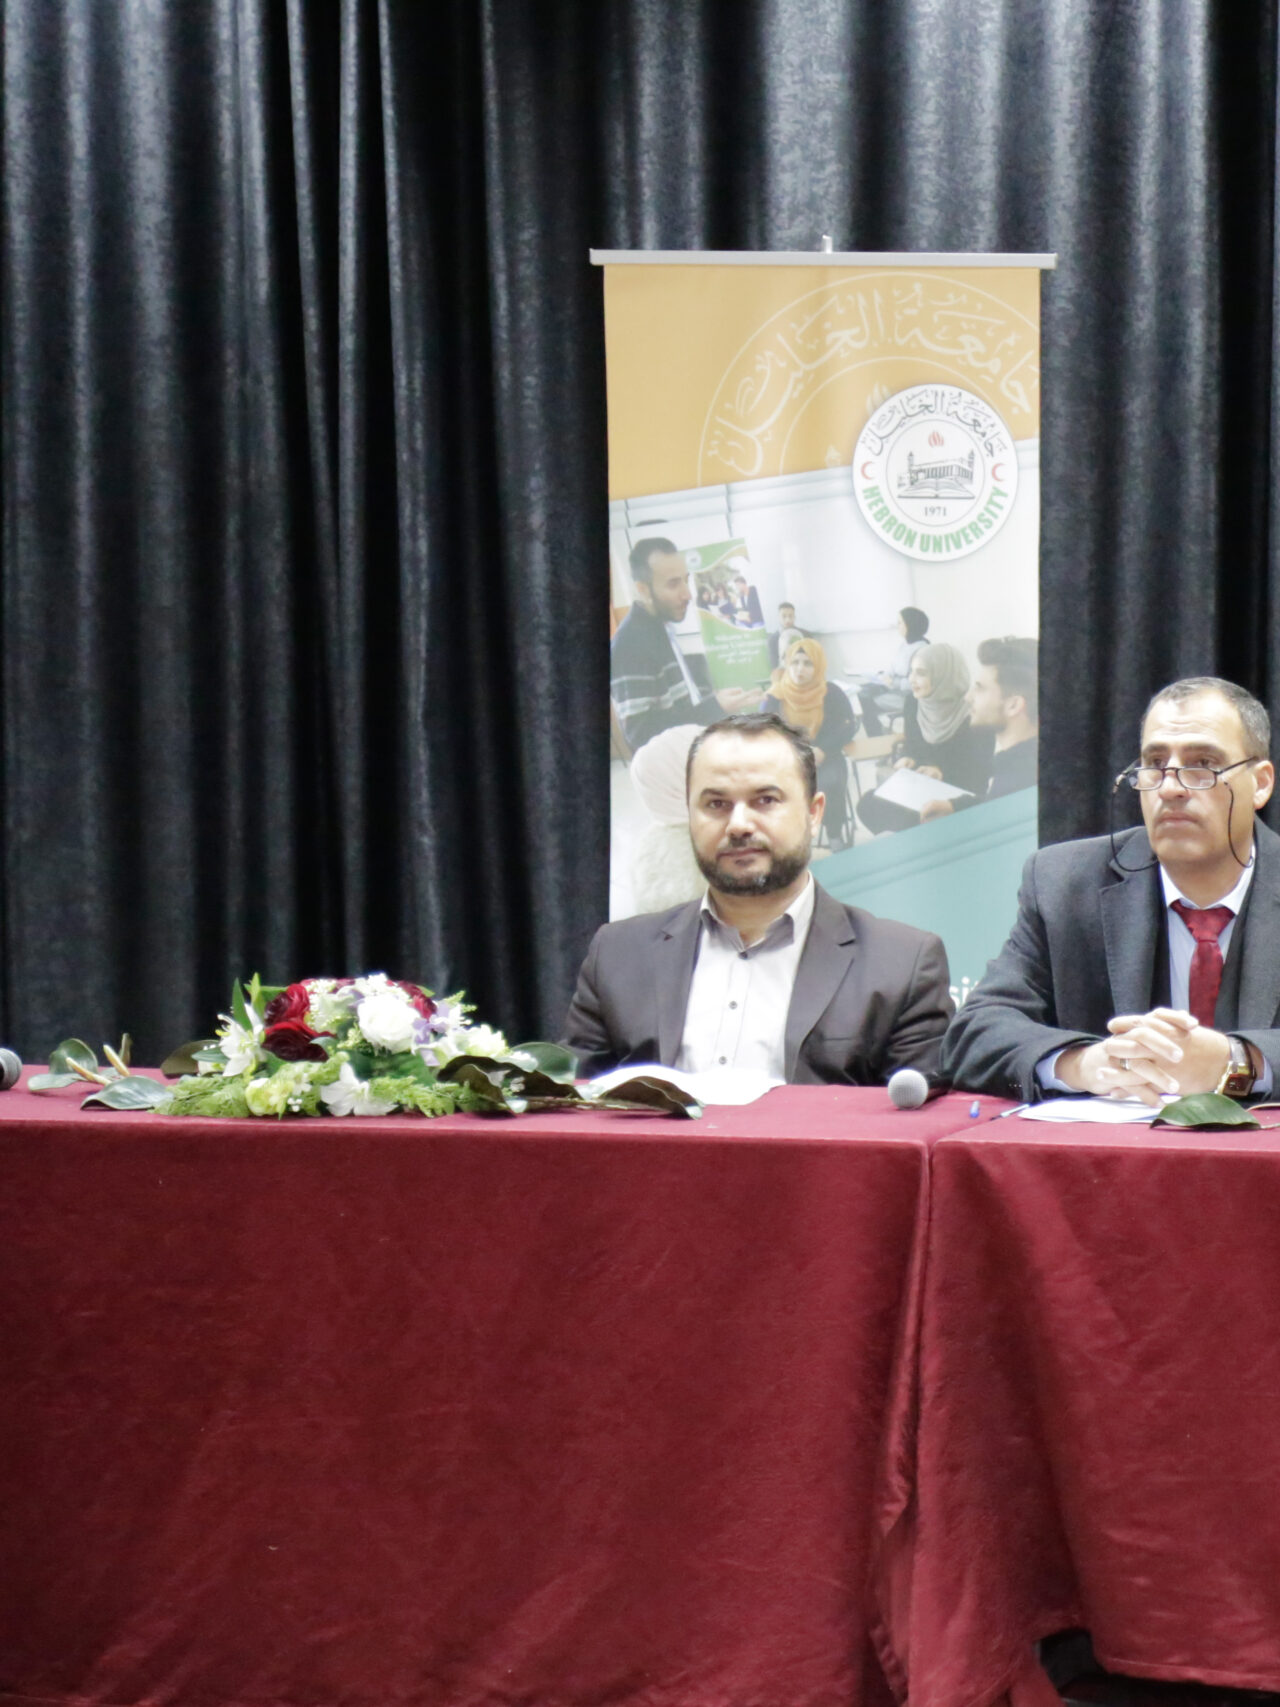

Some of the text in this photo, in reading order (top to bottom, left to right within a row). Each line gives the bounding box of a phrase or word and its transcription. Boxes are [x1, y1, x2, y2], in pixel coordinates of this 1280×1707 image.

[862, 485, 1009, 553] HEBRON UNIVERSITY
[924, 506, 947, 517] 1971
